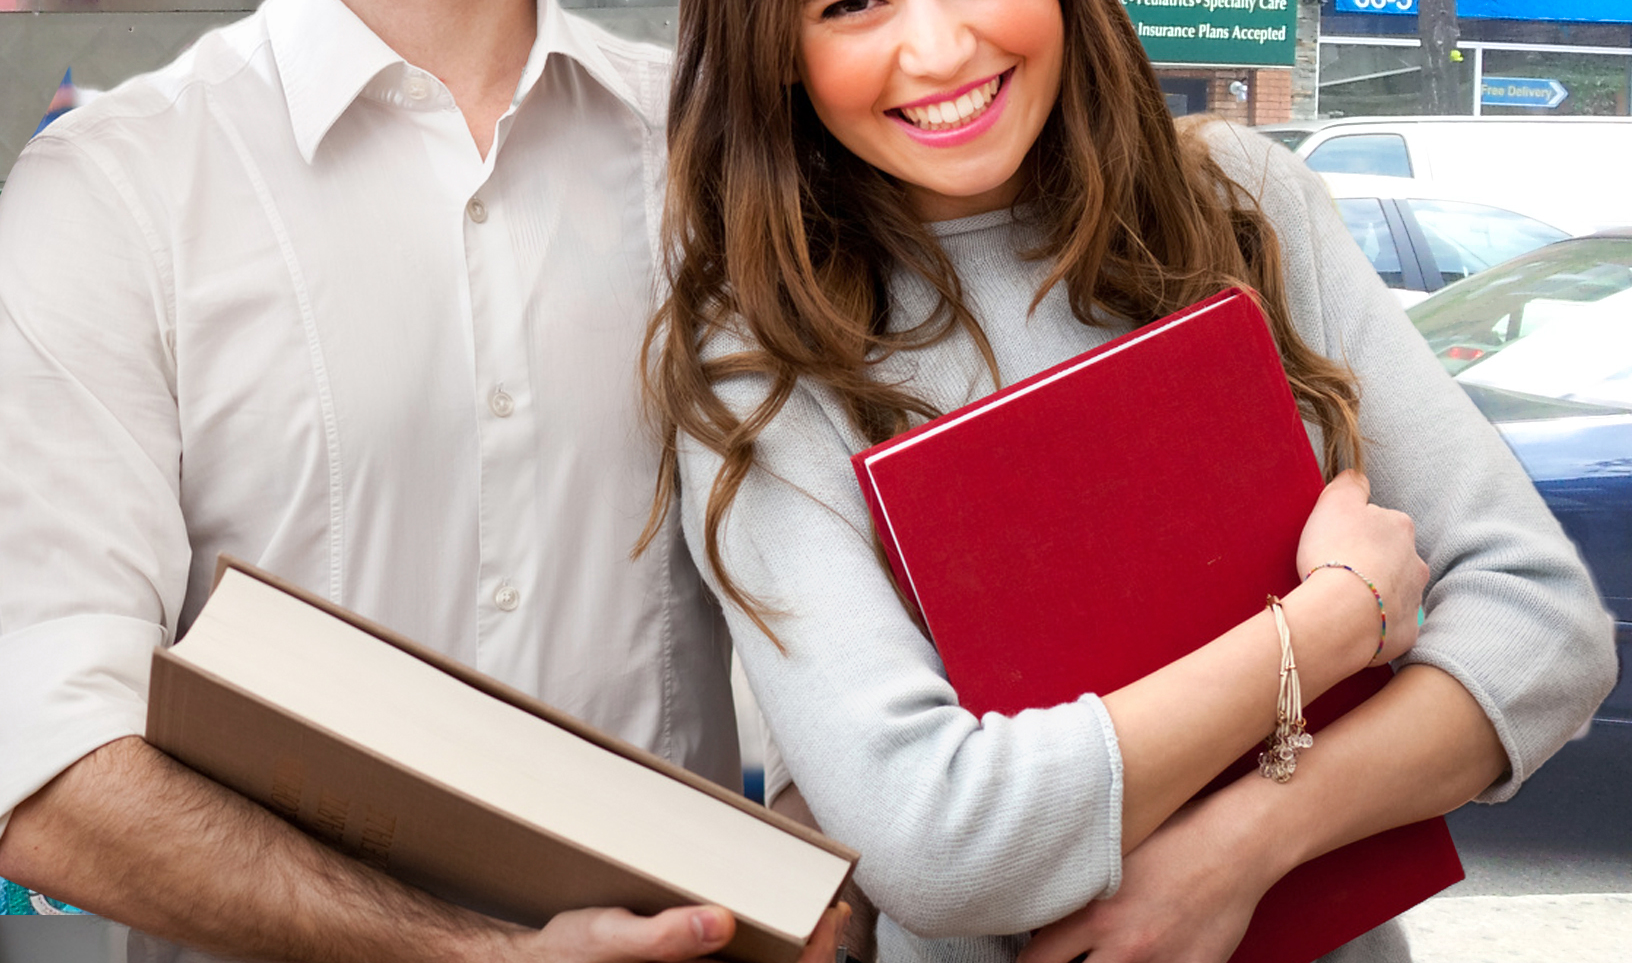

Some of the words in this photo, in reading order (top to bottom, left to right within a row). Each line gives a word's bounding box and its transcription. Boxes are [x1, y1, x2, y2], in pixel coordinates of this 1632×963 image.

[1138, 22, 1195, 38] Insurance
[1198, 23, 1229, 40] Plans
[1232, 25, 1286, 44] Accepted
[1481, 83, 1505, 95] Free
[1508, 85, 1552, 100] Delivery
